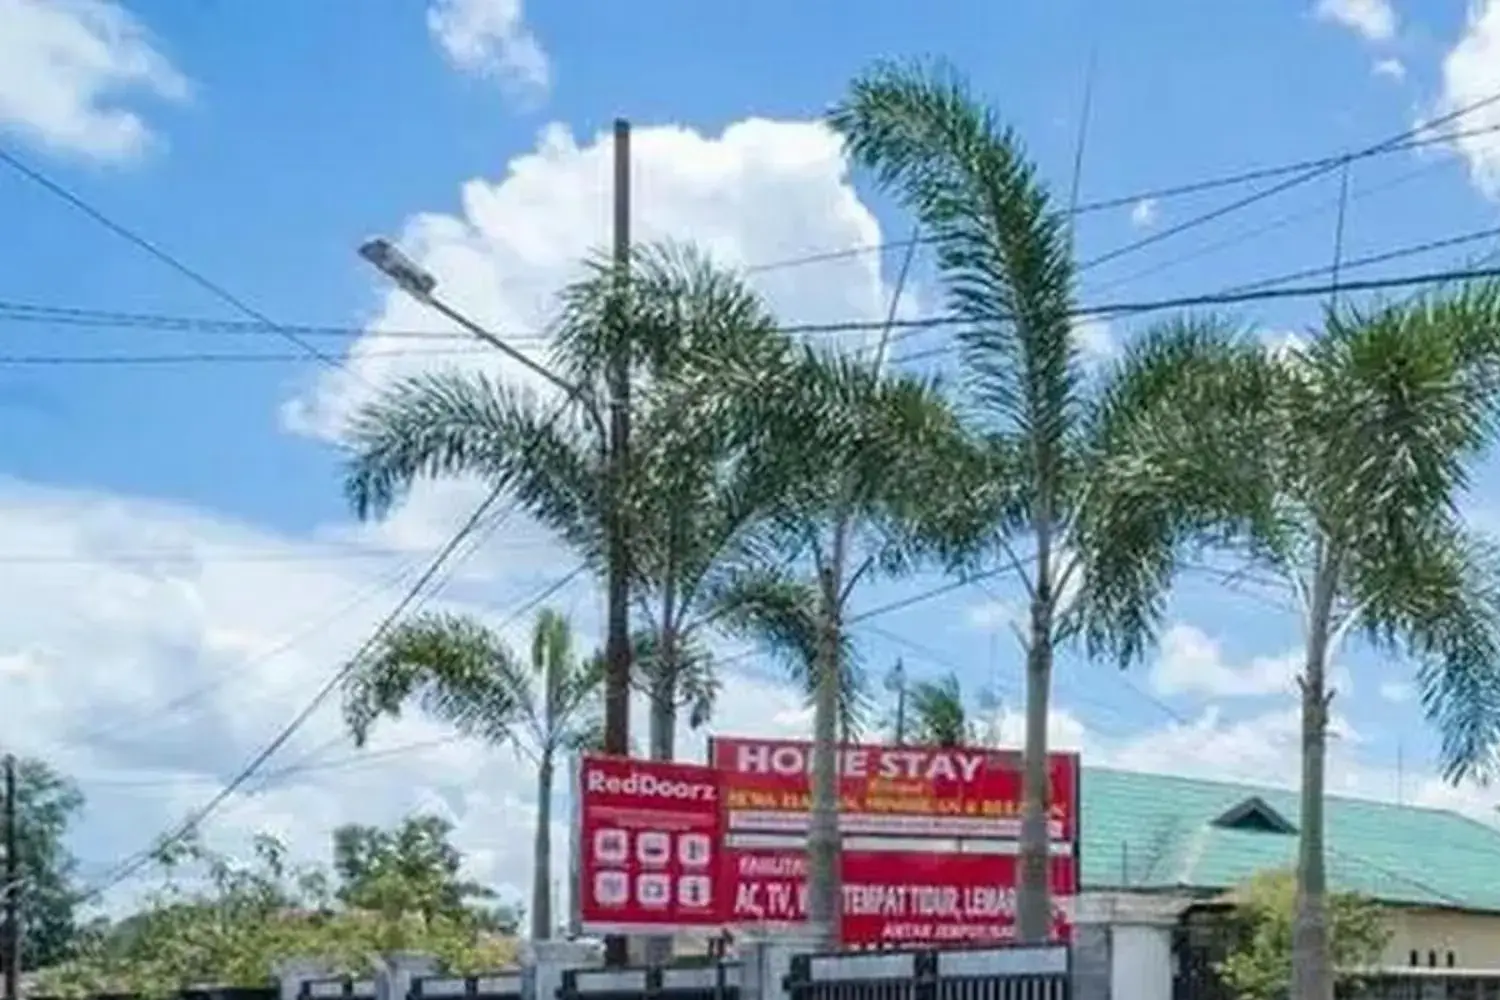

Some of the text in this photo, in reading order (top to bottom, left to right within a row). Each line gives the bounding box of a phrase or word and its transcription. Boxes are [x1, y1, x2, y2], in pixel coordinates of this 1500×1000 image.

[879, 751, 984, 782] STAY
[588, 769, 718, 800] RedDoorz
[734, 882, 765, 918] AC,
[766, 883, 795, 918] TV,
[842, 884, 905, 915] TEMPAT
